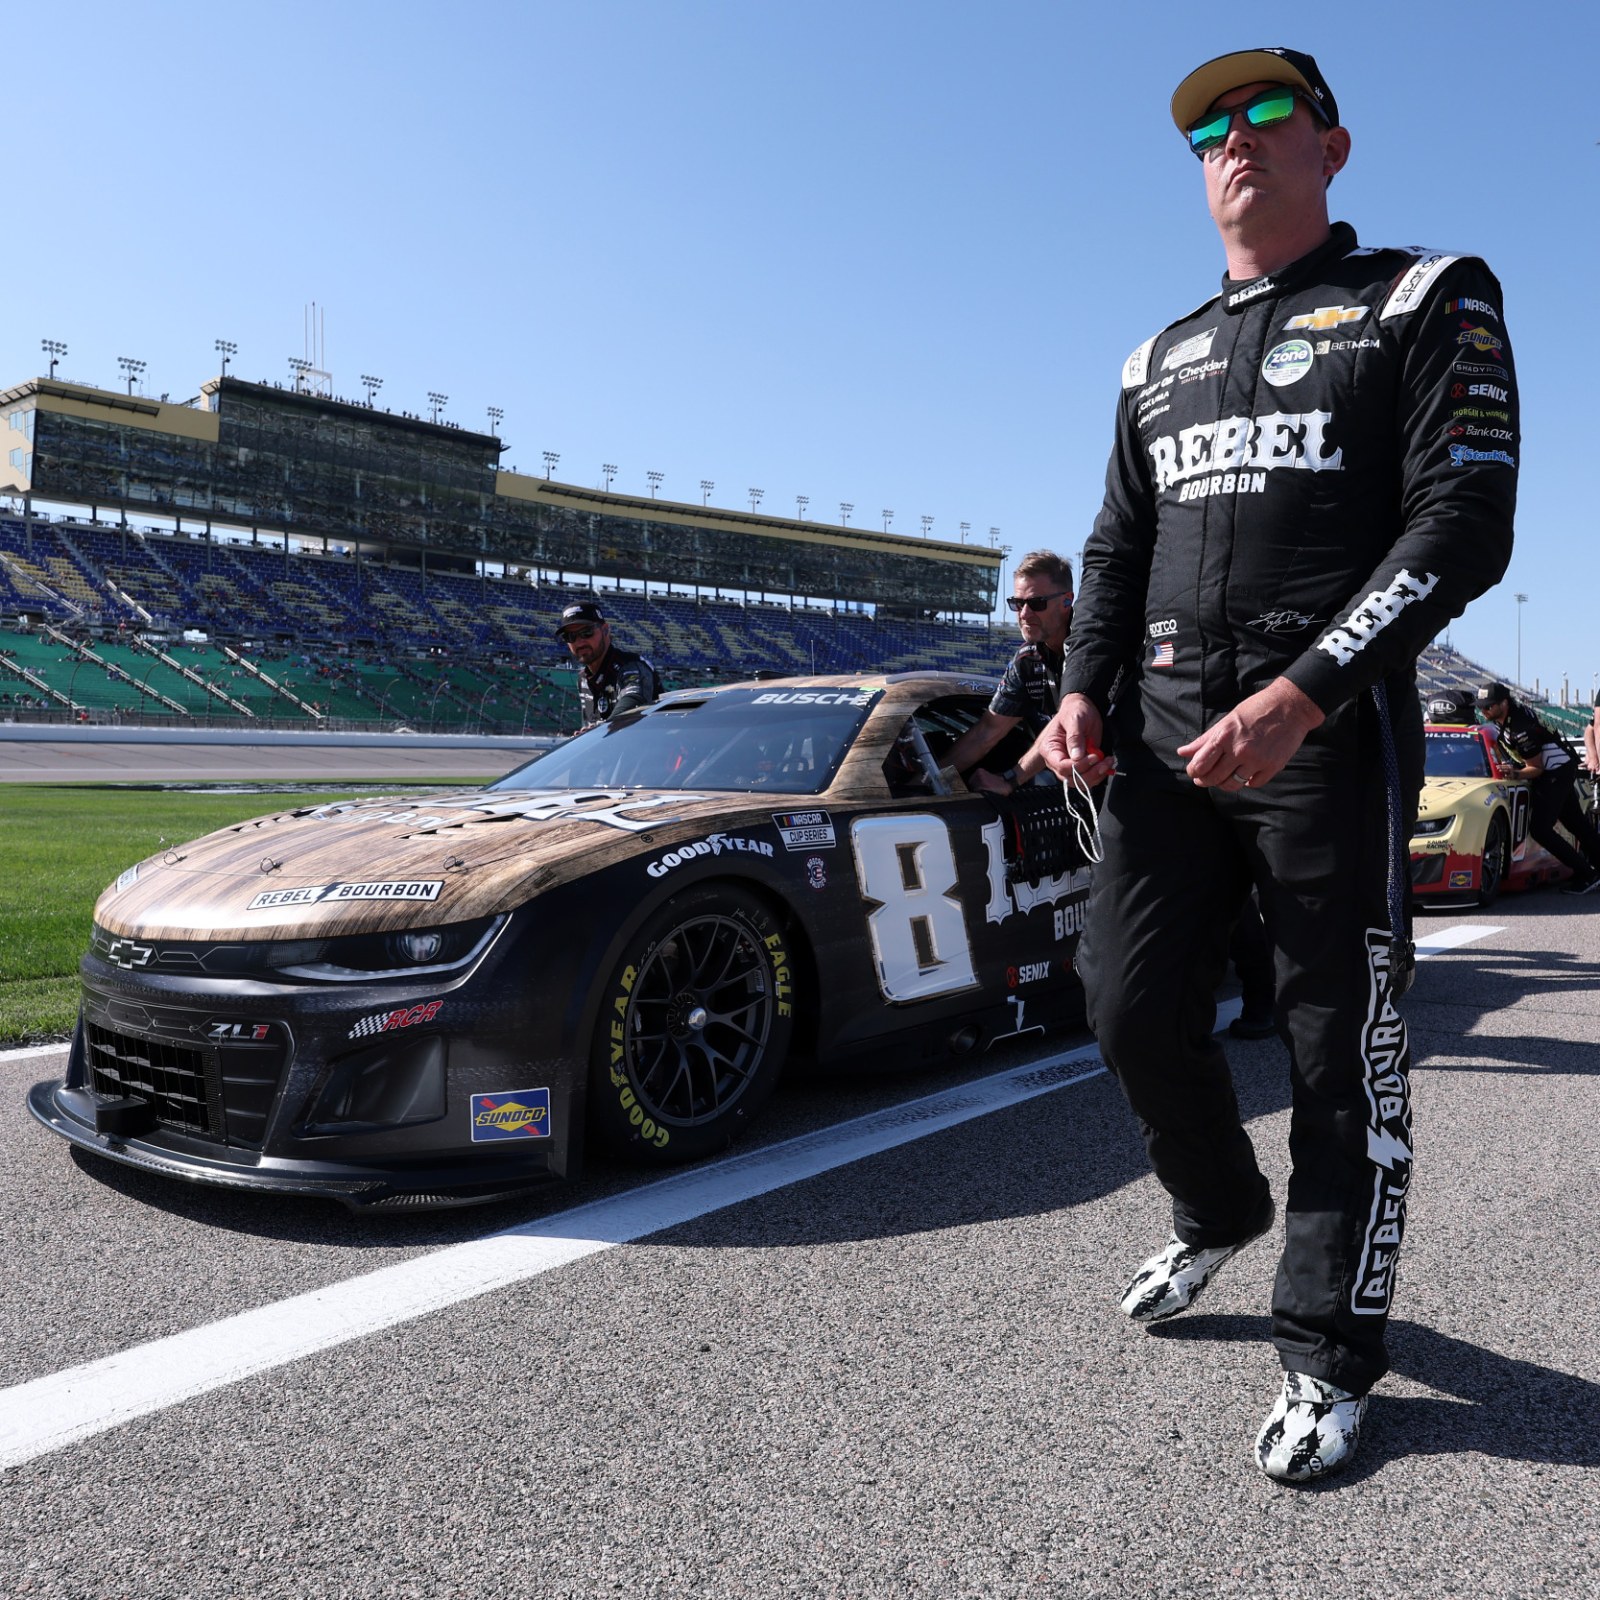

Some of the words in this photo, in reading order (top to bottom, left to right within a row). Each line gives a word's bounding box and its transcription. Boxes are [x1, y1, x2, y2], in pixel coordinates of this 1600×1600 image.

[1229, 277, 1275, 307] REBEL
[1271, 350, 1309, 363] zone
[1331, 339, 1380, 351] BETMGM
[1468, 384, 1508, 402] SENIX
[1149, 409, 1343, 494] REBEL
[1178, 472, 1266, 503] BOURBON
[1149, 619, 1178, 638] sparco
[1317, 568, 1439, 667] REBEL
[751, 693, 861, 705] BUSCH
[792, 813, 823, 827] NASCAR
[789, 831, 804, 842] CUP
[804, 829, 828, 841] SERIES
[646, 833, 774, 878] GOODYEAR
[256, 888, 312, 906] REBEL
[339, 883, 435, 897] BOURBON
[853, 813, 984, 1004] 8
[763, 933, 792, 1018] EAGLE
[1019, 961, 1050, 984] SENIX
[381, 1000, 444, 1032] RCR
[207, 1022, 270, 1040] ZL1
[610, 965, 670, 1147] GOODYEAR
[478, 1107, 545, 1125] SUNOCO
[1362, 1172, 1408, 1298] REBEL
